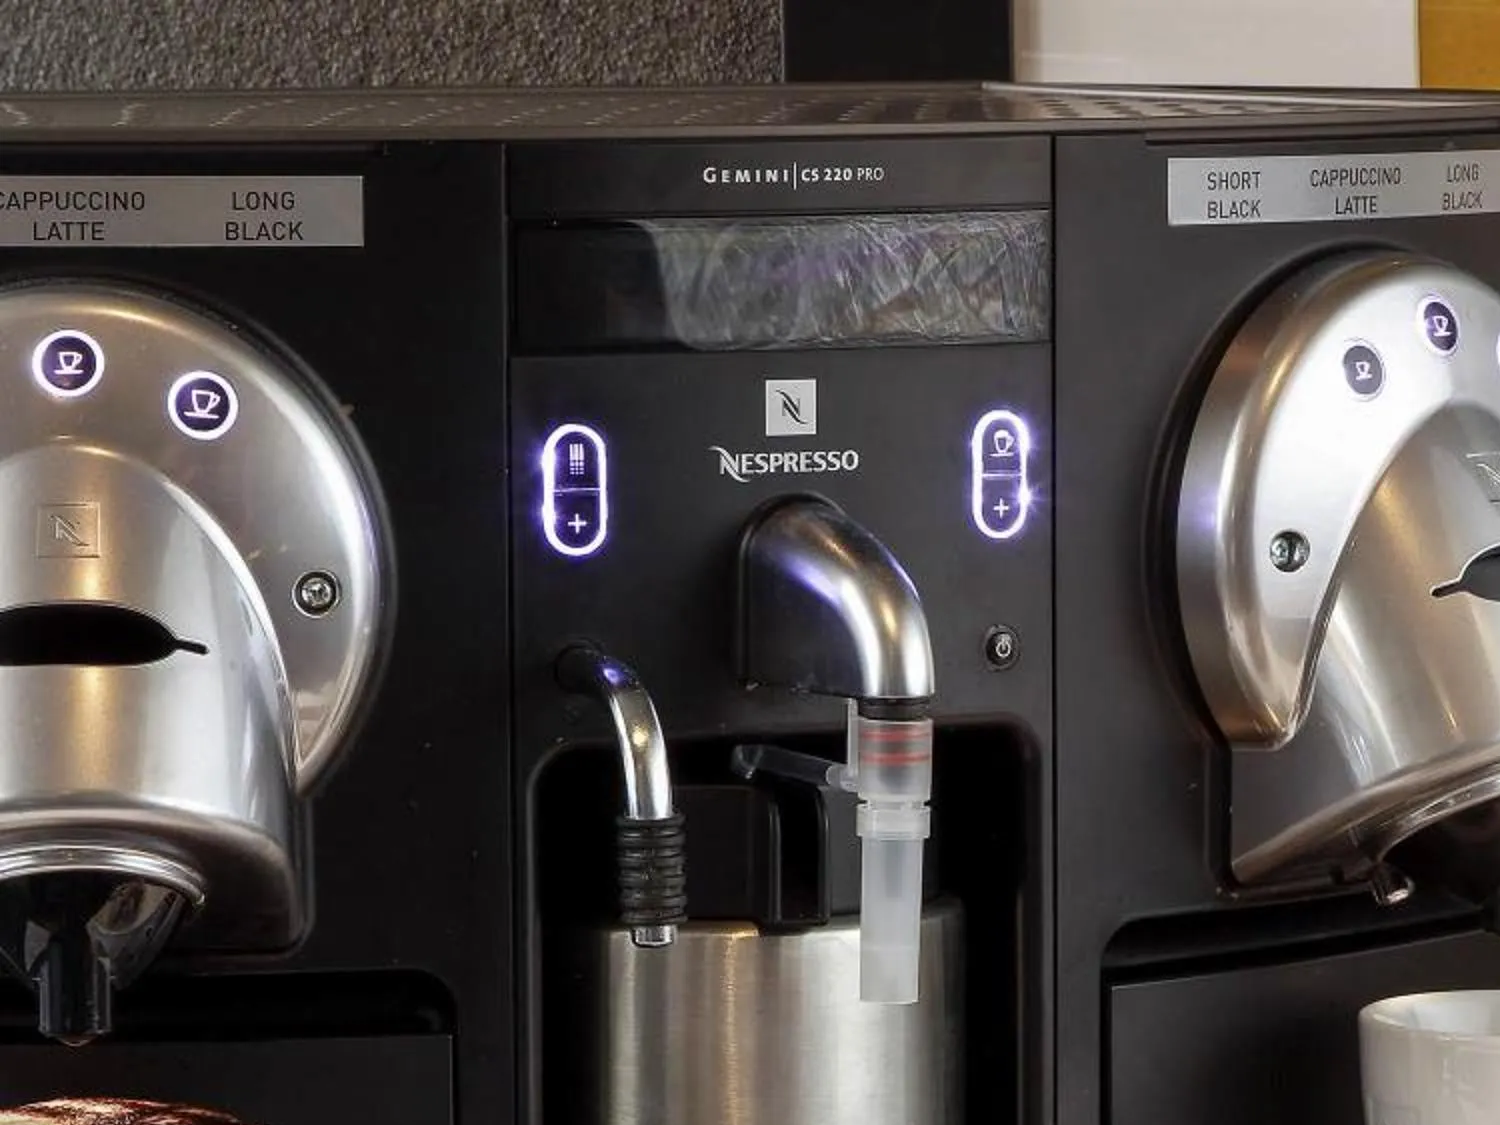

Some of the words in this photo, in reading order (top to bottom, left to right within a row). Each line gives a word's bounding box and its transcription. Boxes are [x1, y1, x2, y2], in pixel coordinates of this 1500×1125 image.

[703, 167, 789, 183] GEMINI
[801, 168, 819, 182] CS
[824, 168, 852, 182] 220
[857, 167, 885, 181] PRO
[1207, 171, 1261, 190] SHORT
[1310, 167, 1401, 187] CAPPUCCINO
[1447, 163, 1479, 183] LONG
[231, 191, 296, 211] LONG
[1207, 200, 1261, 219] BLACK
[1334, 195, 1378, 215] LATTE
[1442, 191, 1483, 211] BLACK
[33, 221, 105, 241] LATTE
[225, 221, 304, 241] BLACK
[708, 445, 859, 482] NESPRESSO
